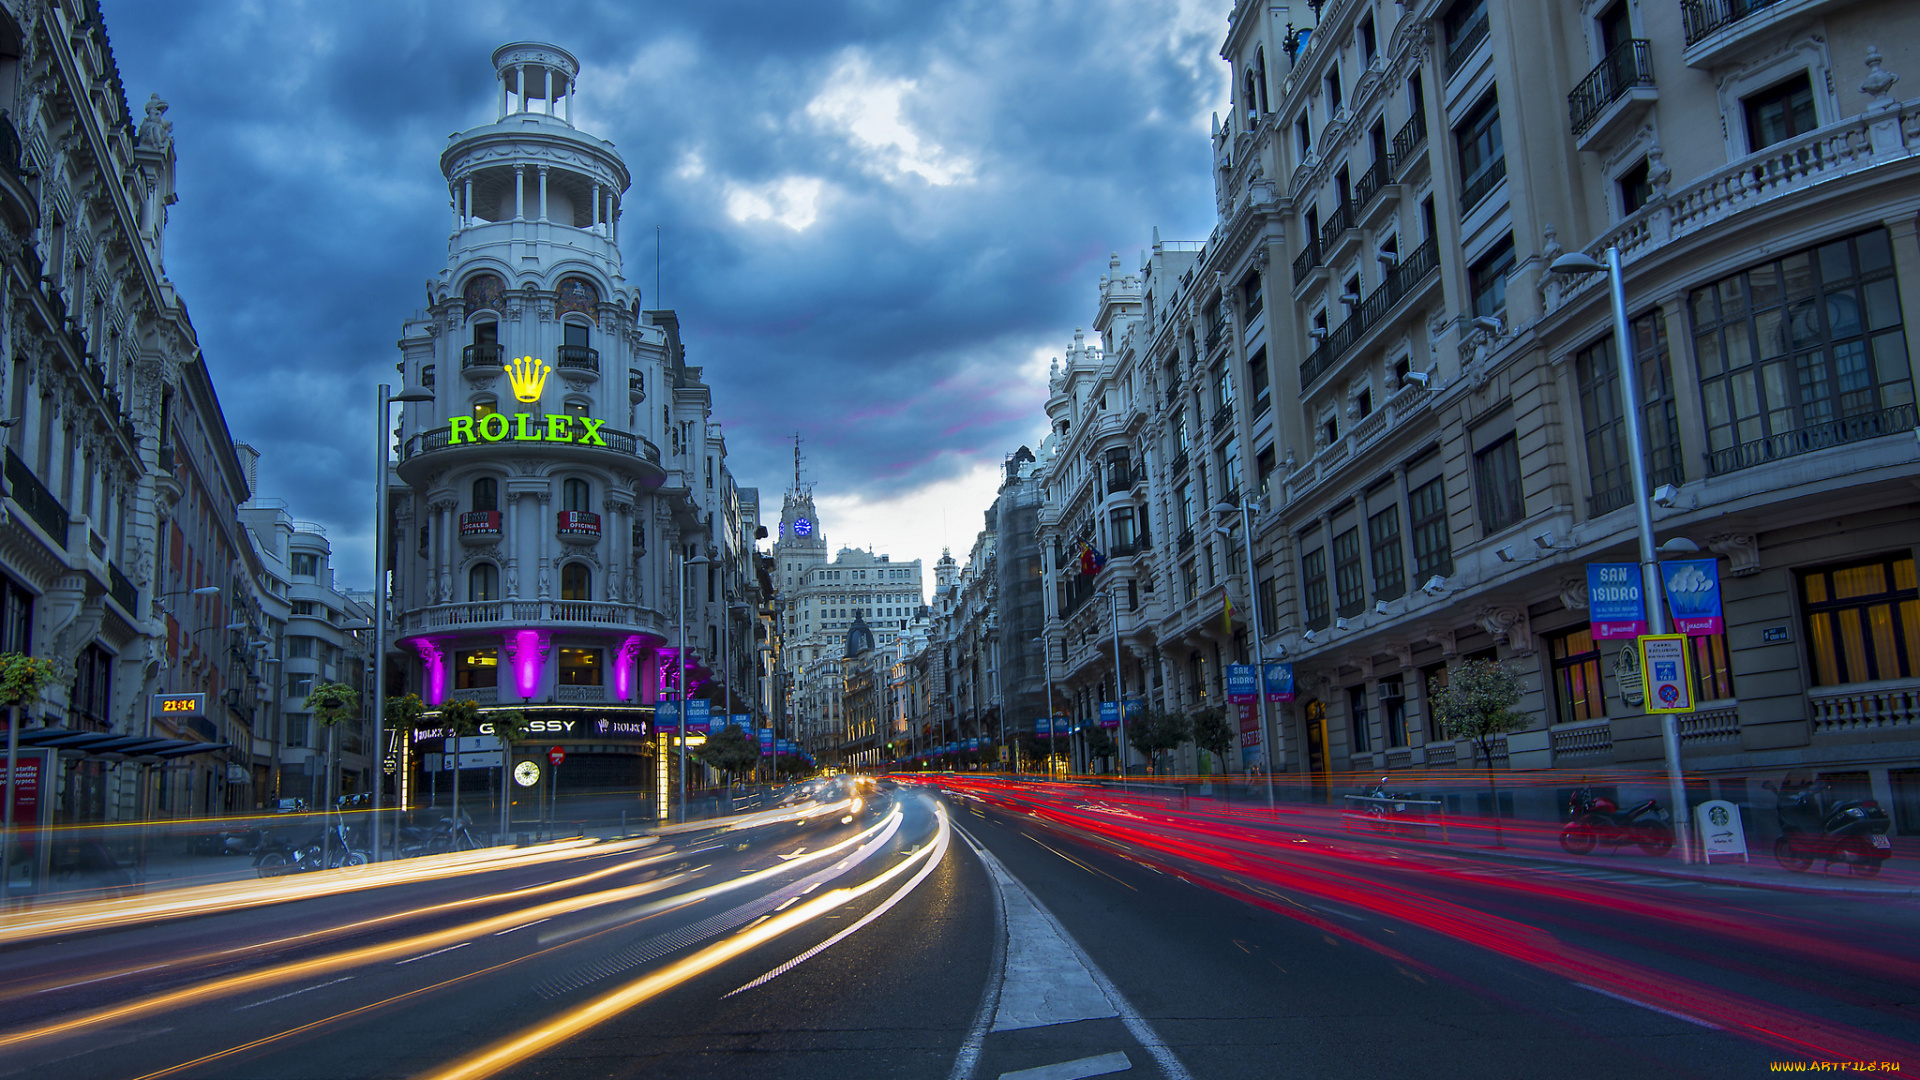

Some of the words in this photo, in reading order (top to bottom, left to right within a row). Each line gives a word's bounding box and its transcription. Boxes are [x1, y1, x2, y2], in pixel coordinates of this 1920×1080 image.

[448, 413, 607, 447] ROLEX
[462, 522, 489, 530] LOCALES
[569, 522, 597, 531] OFICINAS
[1600, 567, 1627, 582] SAN
[1592, 586, 1638, 602] ISIDRO
[1233, 667, 1249, 675] SAN
[1229, 676, 1254, 685] ISIDRO
[163, 699, 195, 711] 21:14
[479, 720, 576, 734] GSSY
[613, 722, 641, 733] ROLEX
